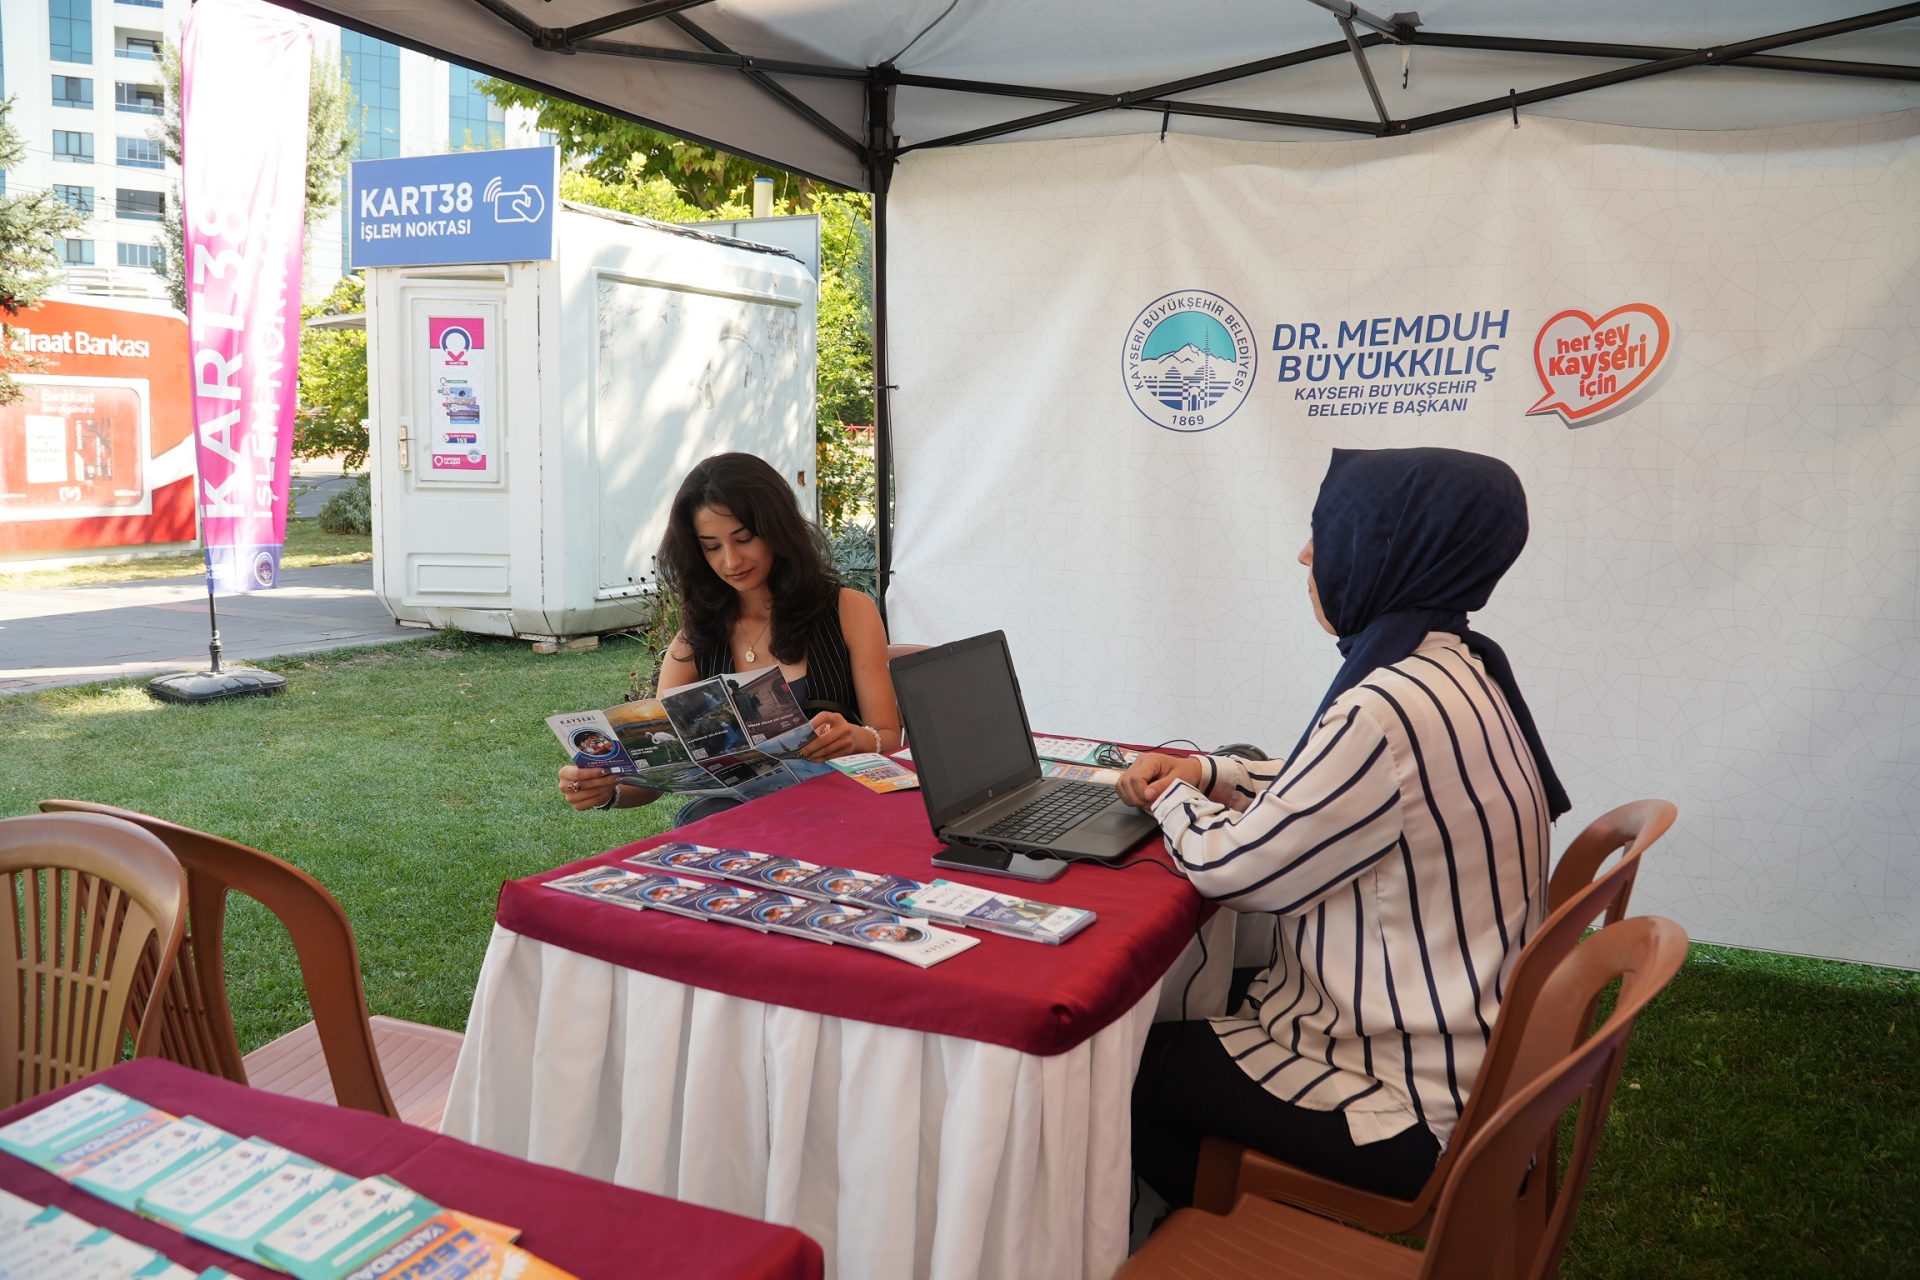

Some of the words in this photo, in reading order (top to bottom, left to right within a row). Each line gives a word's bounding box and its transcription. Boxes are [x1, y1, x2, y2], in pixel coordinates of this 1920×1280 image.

[361, 182, 474, 218] KART38
[360, 221, 402, 242] İŞLEM
[405, 219, 471, 237] NOKTASI
[10, 327, 73, 354] Ziraat
[75, 331, 150, 358] Bankası
[1130, 329, 1146, 390] KAYSERİ
[1143, 297, 1225, 329] BÜYÜKŞEHİR
[1225, 314, 1252, 393] BELEDİYESİ
[1273, 322, 1328, 350] DR.
[1337, 309, 1510, 348] MEMDUH
[1557, 335, 1591, 354] her
[1594, 323, 1630, 351] şey
[192, 197, 249, 518] KART38
[1278, 344, 1500, 382] BÜYÜKKILIÇ
[1549, 333, 1647, 380] Kayseri
[1579, 373, 1617, 400] için
[1172, 415, 1204, 426] 1869
[1392, 398, 1468, 416] BAŞKANI
